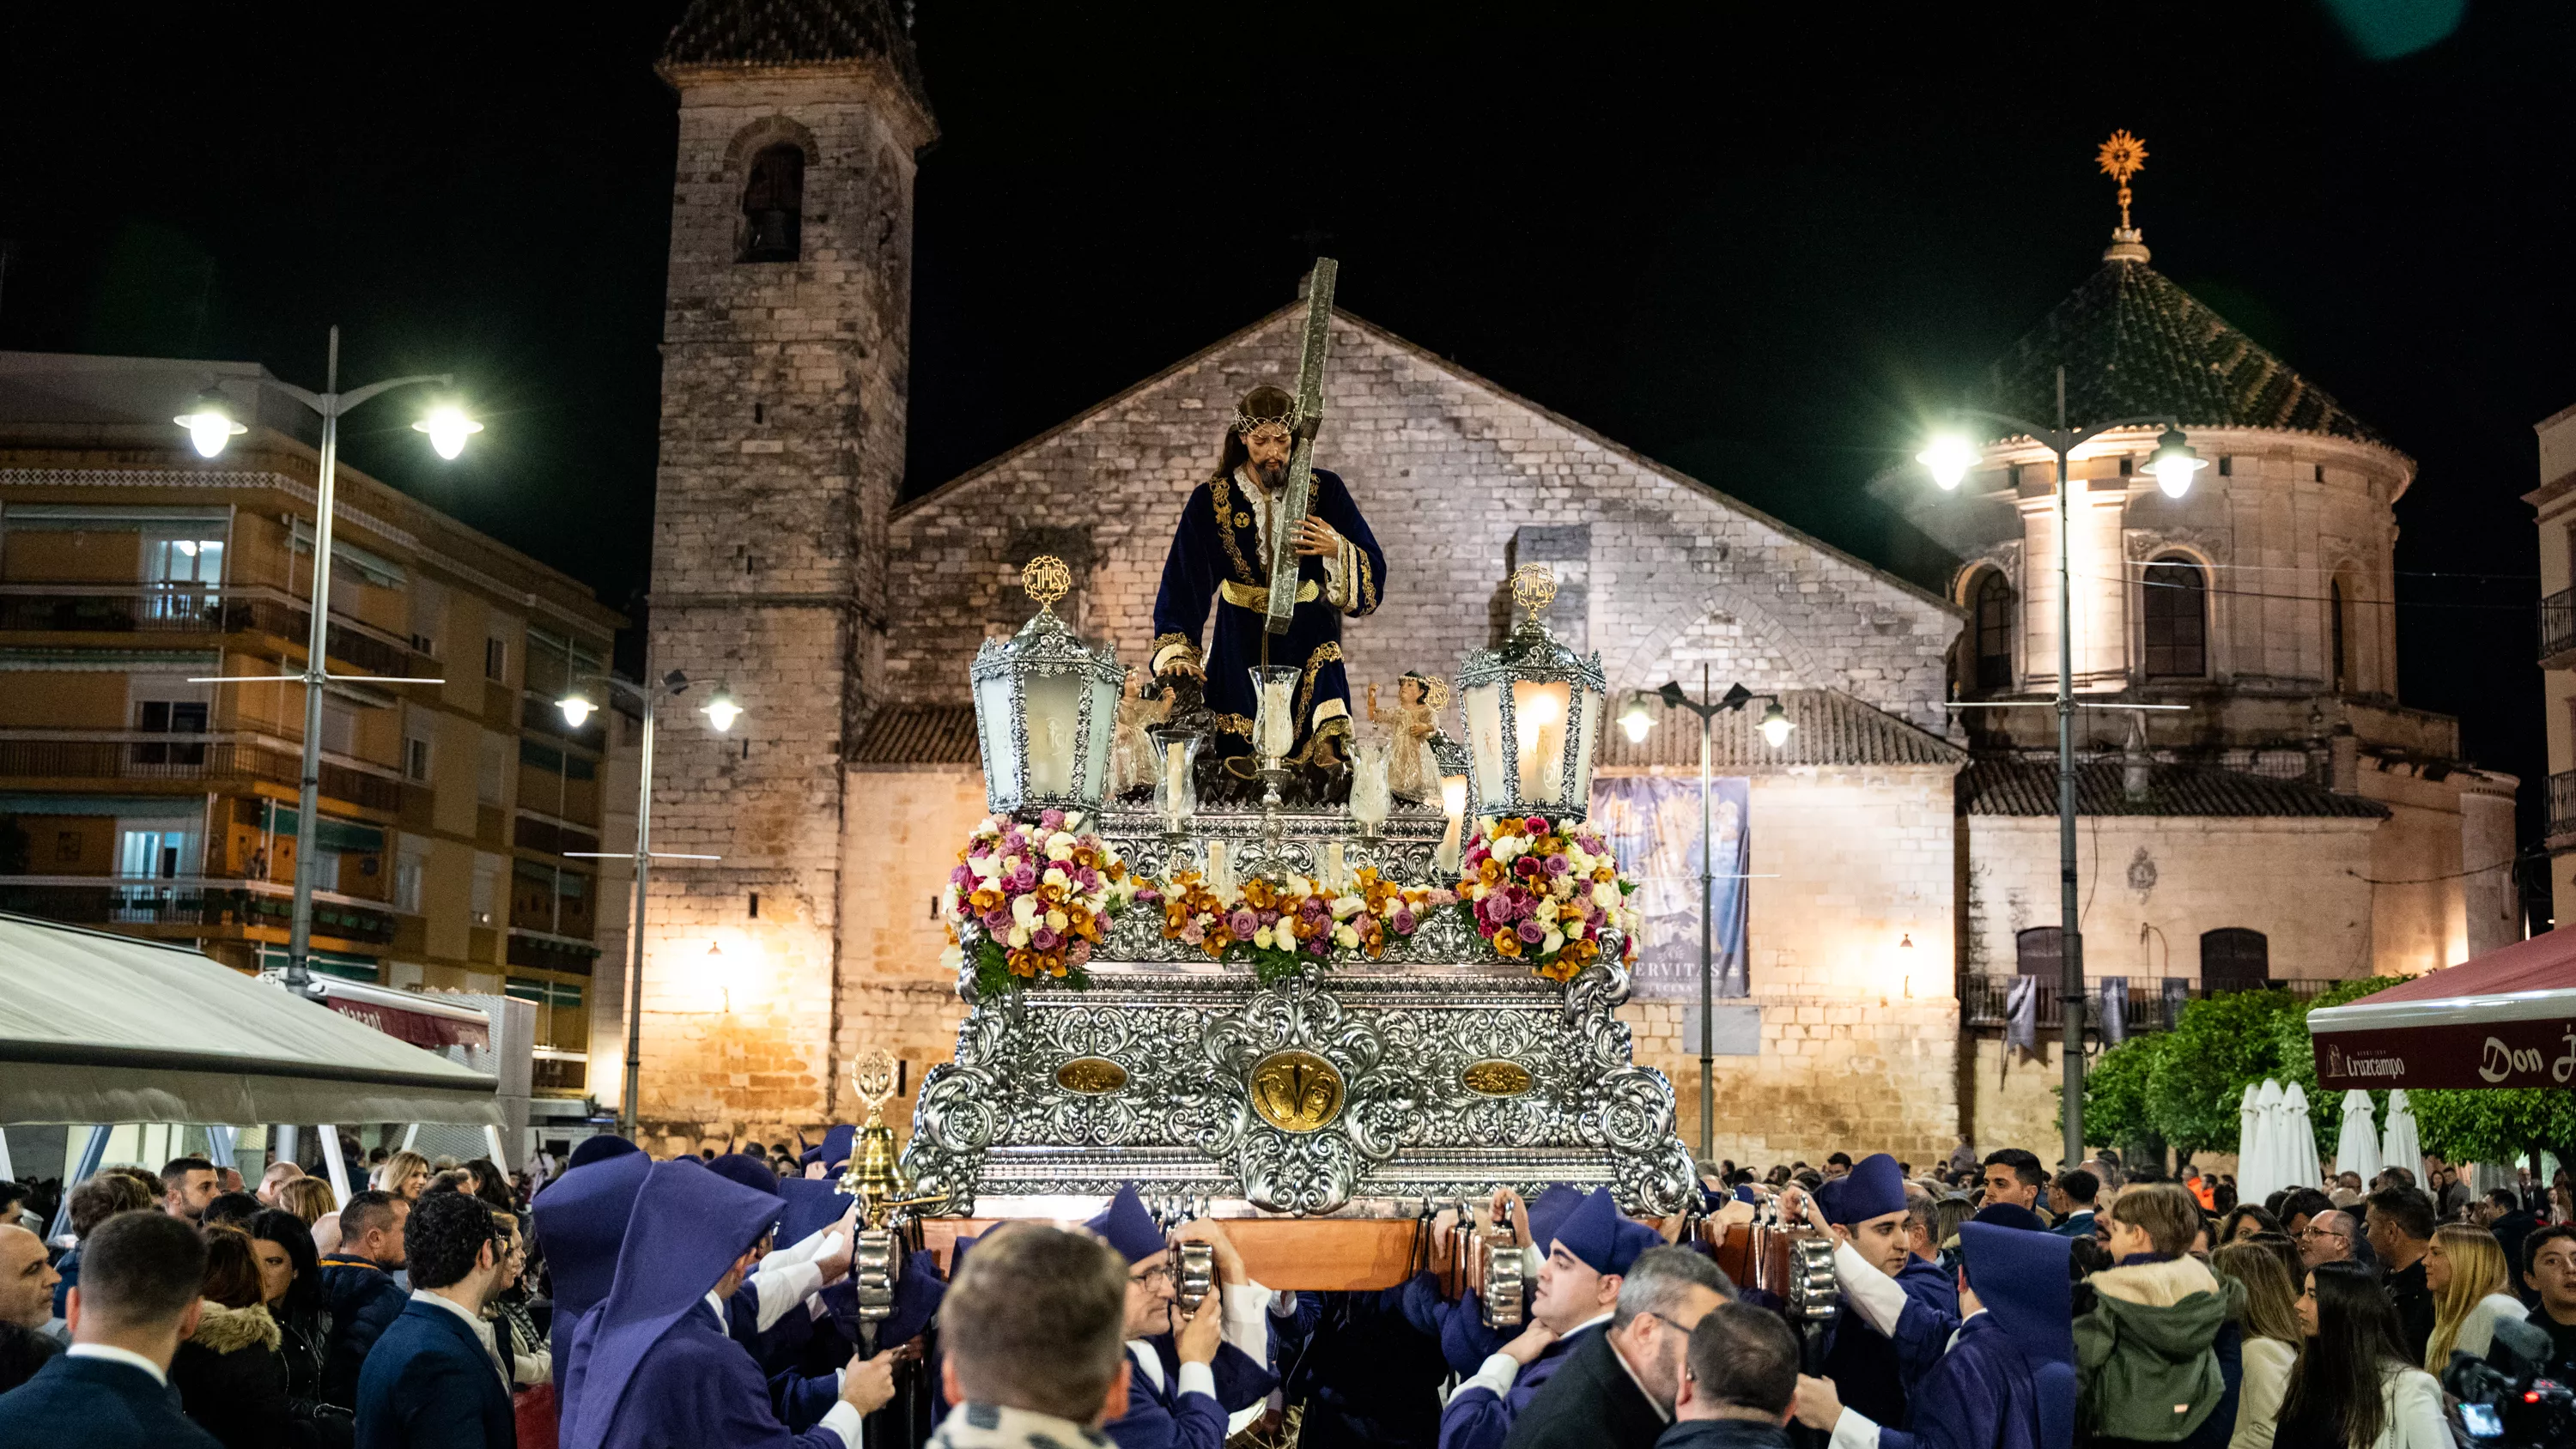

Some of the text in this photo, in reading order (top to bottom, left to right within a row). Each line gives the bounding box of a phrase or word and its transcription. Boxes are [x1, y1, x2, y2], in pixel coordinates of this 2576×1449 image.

[1634, 962, 1720, 977] ERVITS
[2347, 1054, 2404, 1079] Cruzcampo
[2479, 1036, 2543, 1082] Don
